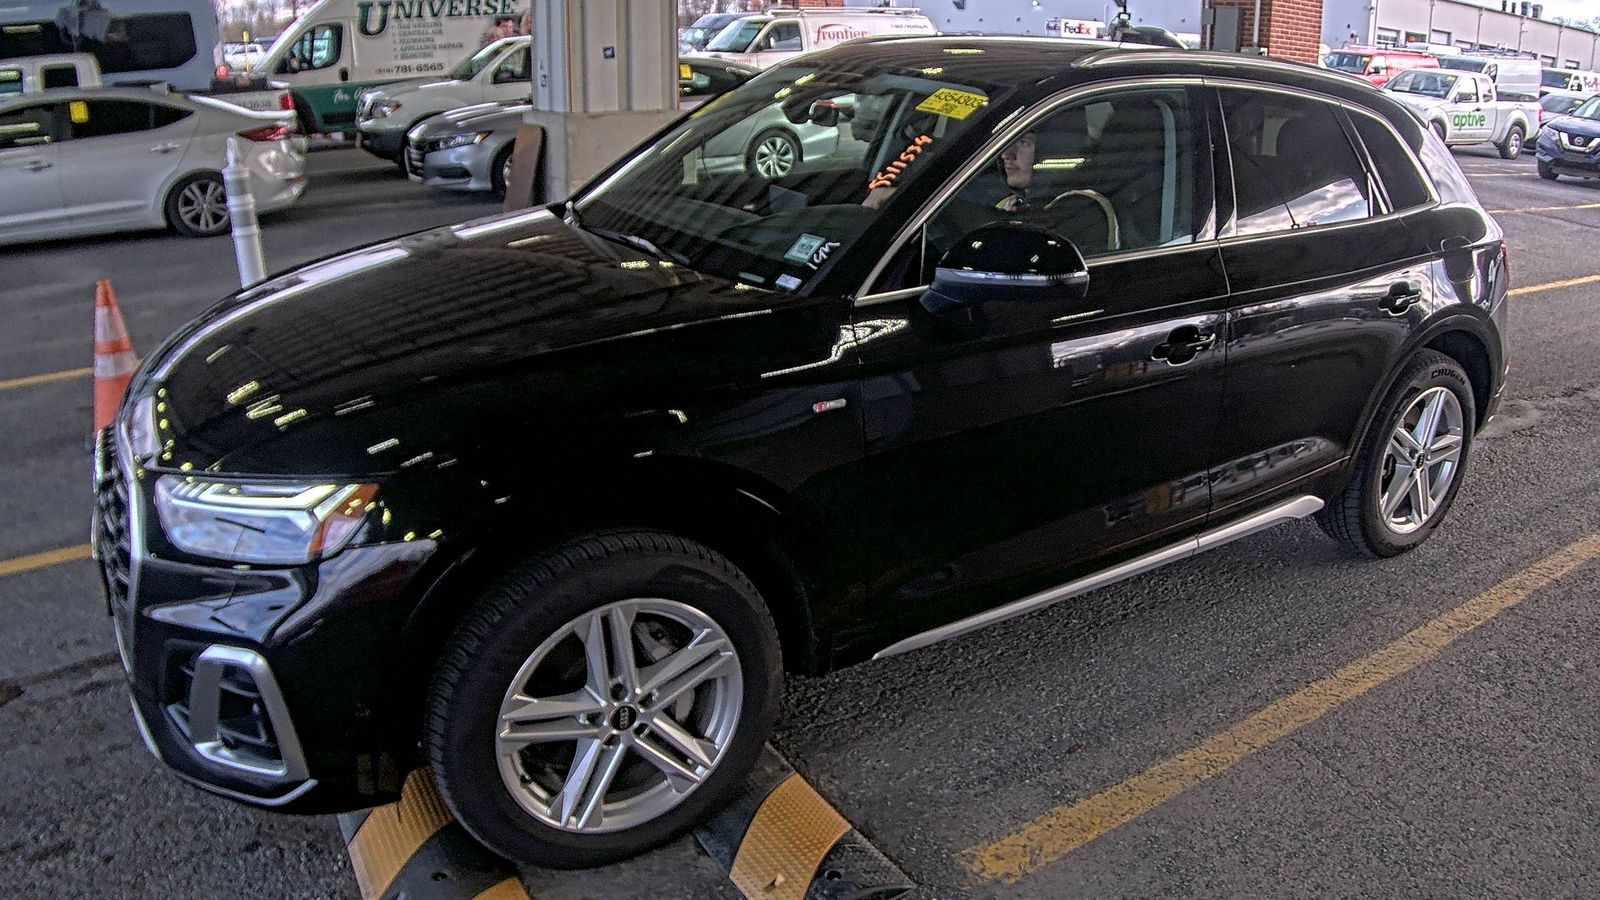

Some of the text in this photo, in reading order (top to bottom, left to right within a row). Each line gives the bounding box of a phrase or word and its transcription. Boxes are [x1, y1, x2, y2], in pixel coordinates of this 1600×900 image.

[813, 24, 868, 44] frontier
[1063, 21, 1091, 35] FedEx
[394, 62, 444, 74] 781-6565
[1453, 112, 1486, 131] aptive
